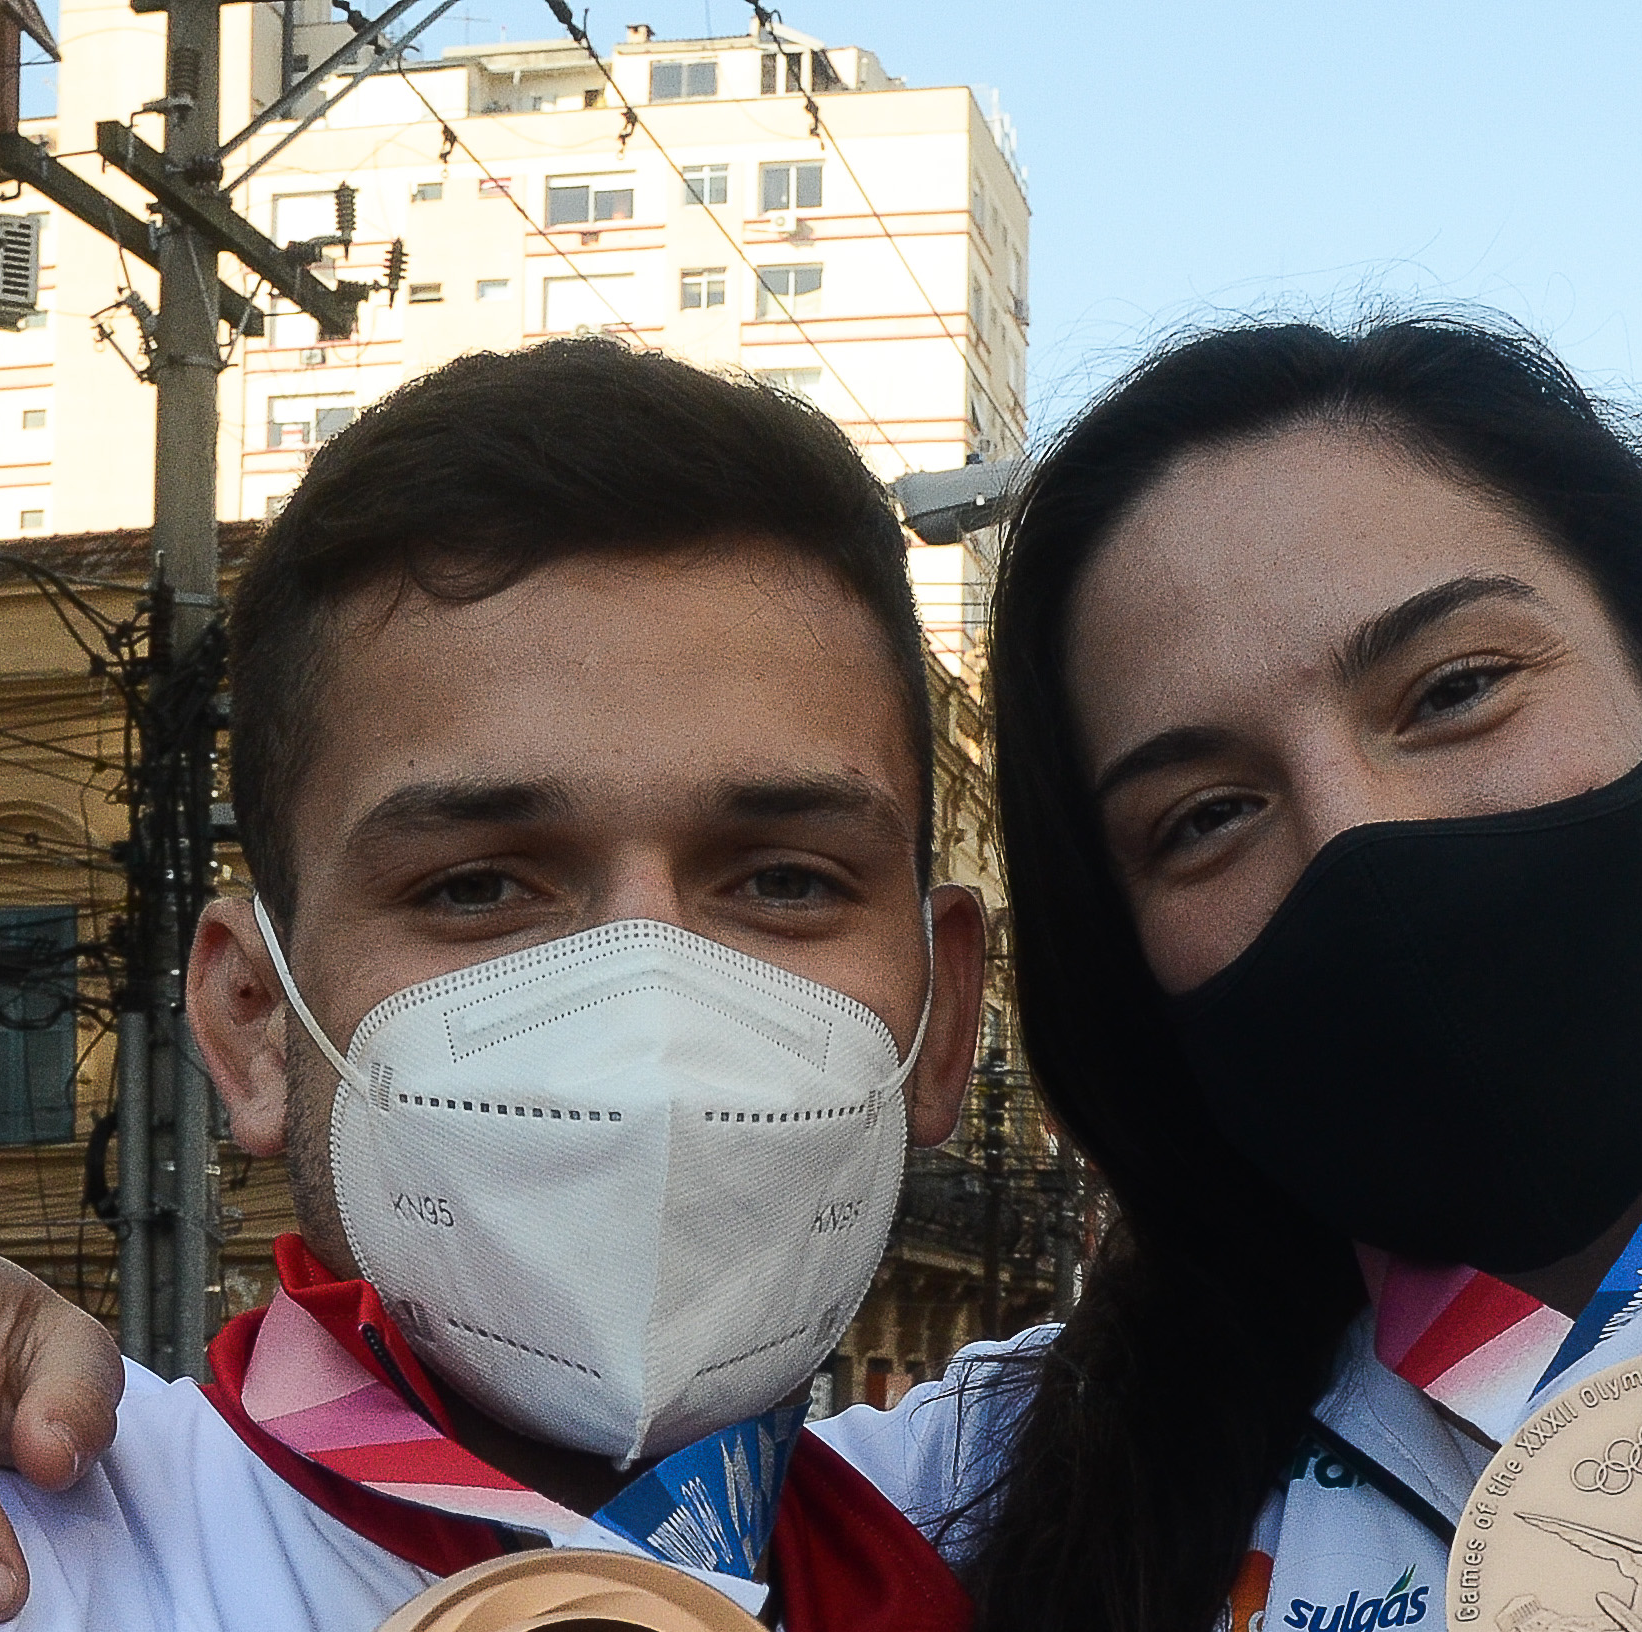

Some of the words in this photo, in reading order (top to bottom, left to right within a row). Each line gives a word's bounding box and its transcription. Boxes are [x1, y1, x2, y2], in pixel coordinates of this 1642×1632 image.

[388, 1190, 455, 1228] KN95
[1515, 1401, 1580, 1458] XXXII
[1485, 1457, 1524, 1498] the
[1474, 1501, 1498, 1530] of
[1455, 1538, 1487, 1623] Games
